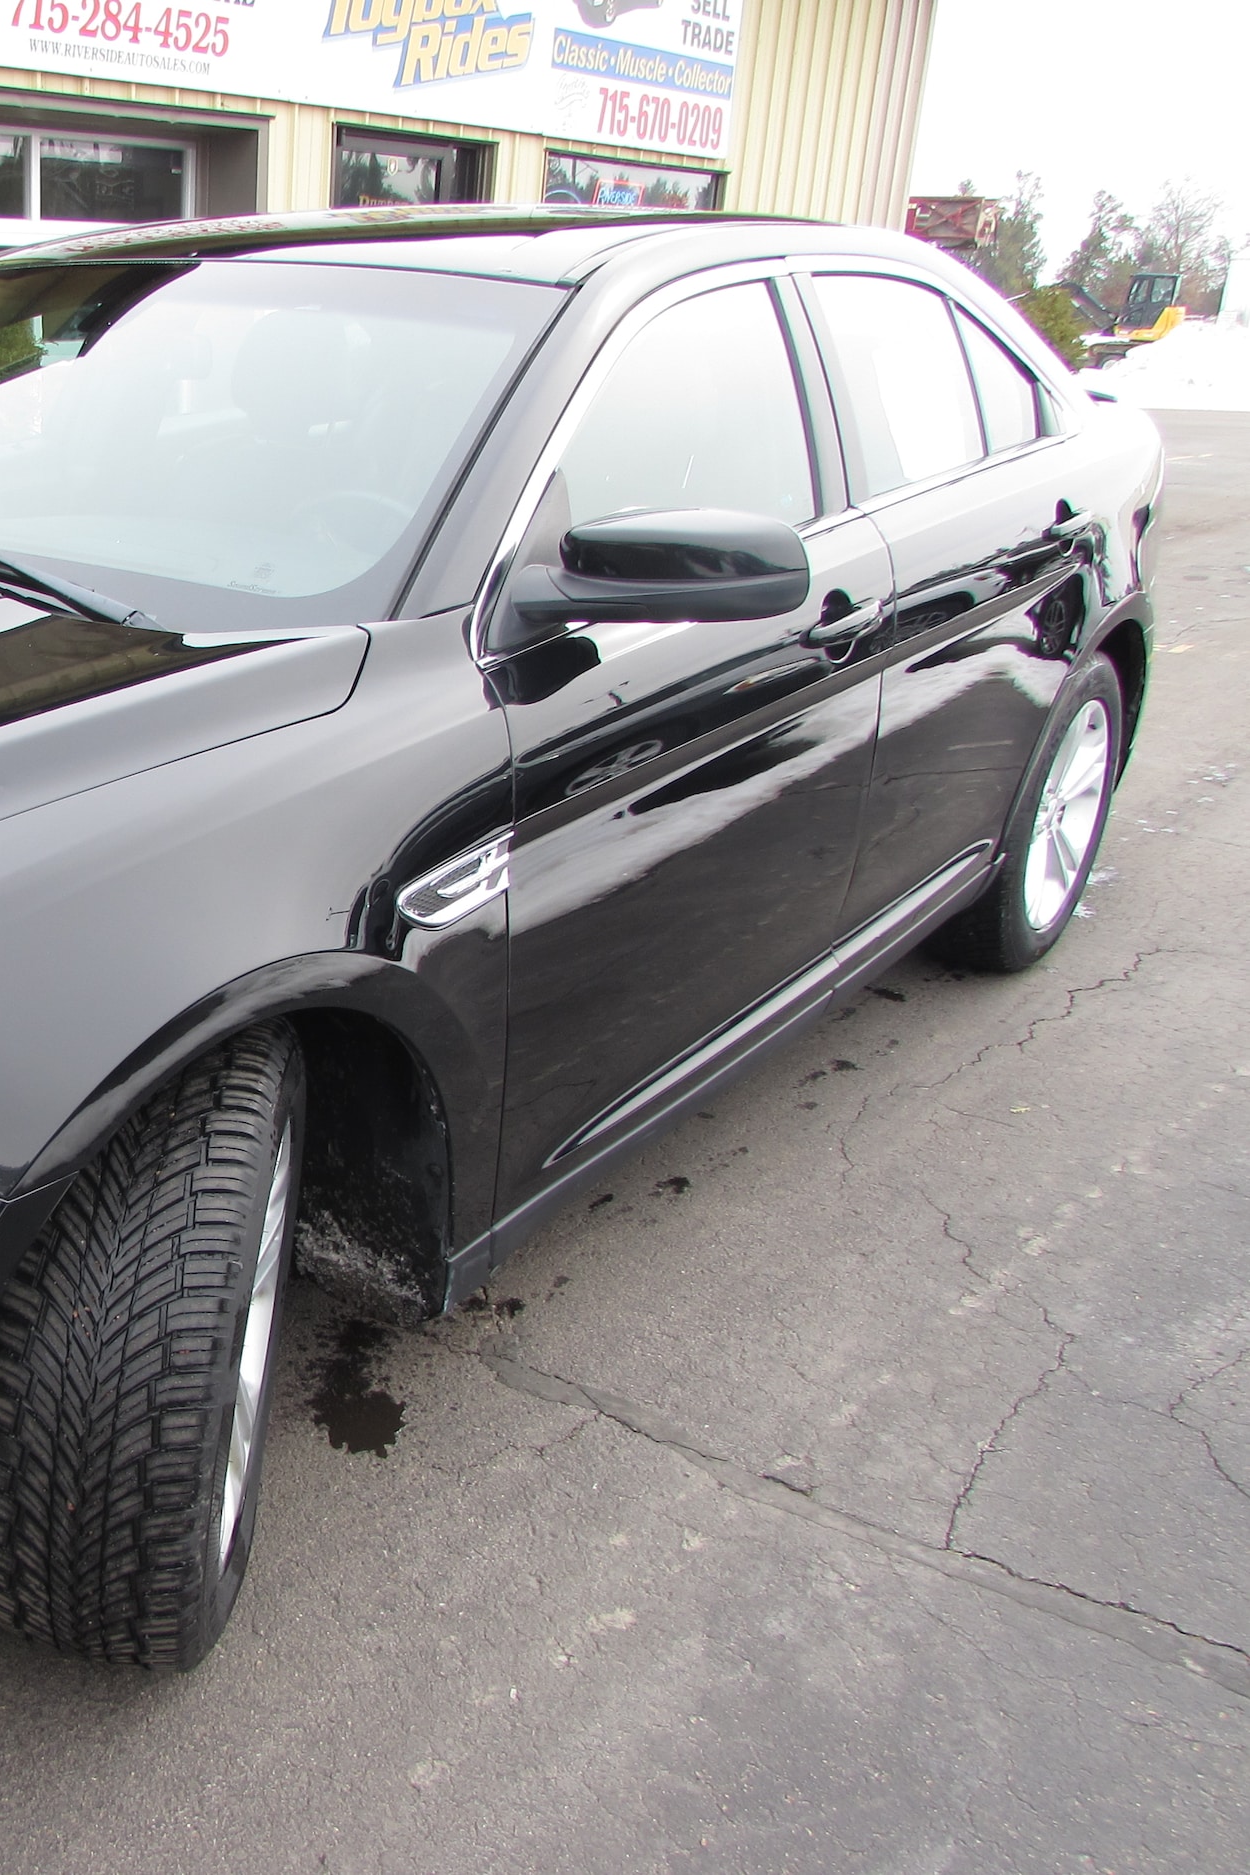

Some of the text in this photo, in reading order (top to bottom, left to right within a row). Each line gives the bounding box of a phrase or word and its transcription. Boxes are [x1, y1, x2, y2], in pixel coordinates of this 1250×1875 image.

[12, 0, 230, 57] 715-284-4525
[681, 19, 735, 56] TRADE
[691, 0, 730, 22] SELL
[28, 38, 211, 76] WWW.RIVERSIDEAUTOSALES.COM
[398, 14, 534, 87] Rides
[553, 34, 733, 96] Classic Muscle Collector
[597, 87, 724, 151] 715-670-0209
